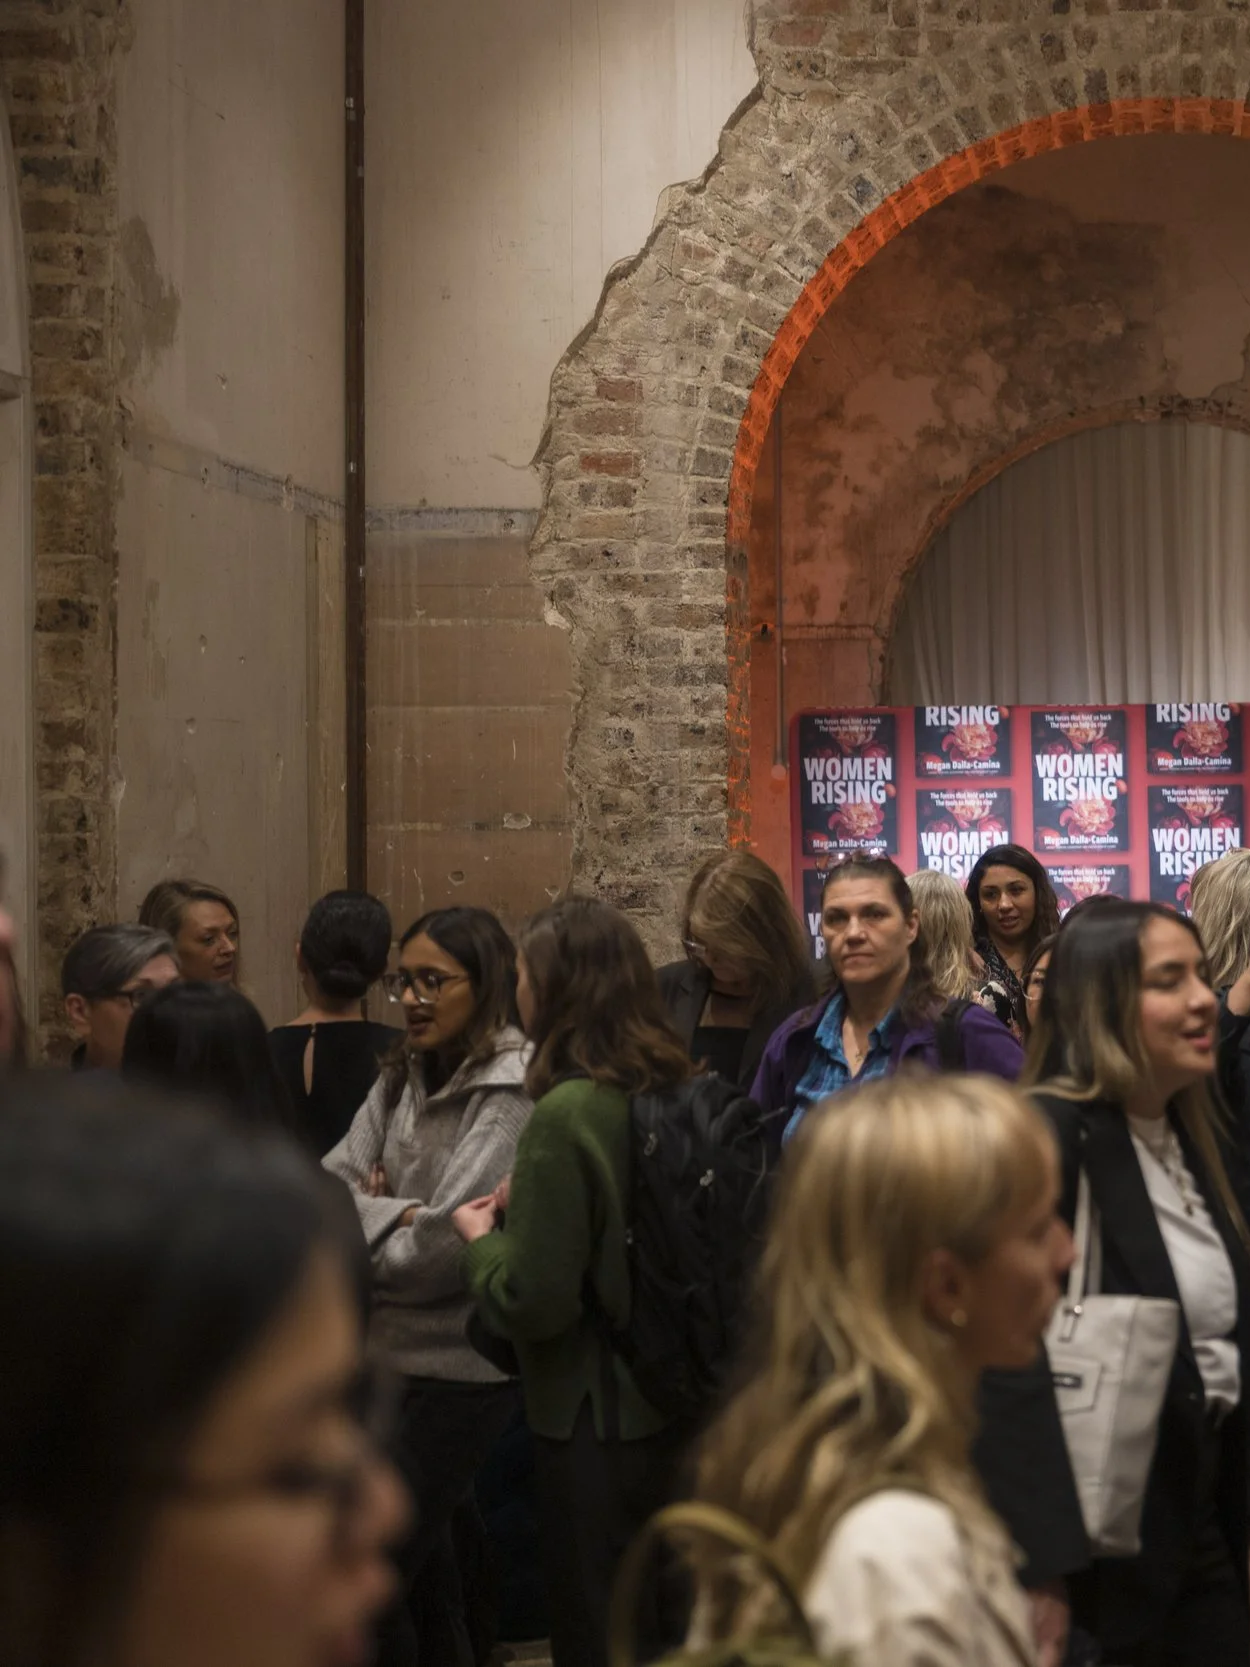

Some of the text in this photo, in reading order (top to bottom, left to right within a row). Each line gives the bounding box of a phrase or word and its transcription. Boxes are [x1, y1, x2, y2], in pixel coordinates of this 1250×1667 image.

[925, 705, 1000, 726] RISING
[1100, 713, 1112, 721] back
[1156, 703, 1230, 722] RISING
[840, 717, 850, 725] that
[803, 757, 892, 780] WOMEN
[926, 759, 1001, 773] Megan Dalla-Camina
[1035, 753, 1123, 778] WOMEN
[1158, 756, 1232, 768] Megan Dalla-Camina
[811, 780, 886, 804] RISING
[985, 791, 997, 799] back
[1043, 777, 1118, 801] RISING
[1162, 788, 1170, 796] The
[1171, 788, 1187, 796] forces
[1187, 788, 1198, 796] that
[813, 838, 887, 850] Megan Dalla-Camina
[1044, 834, 1119, 847] Megan Dalla-Camina
[1152, 828, 1240, 852] WOMEN
[928, 854, 979, 880] RISI
[1048, 868, 1057, 876] The
[1058, 868, 1073, 876] forces
[1073, 868, 1084, 876] that
[1103, 867, 1115, 876] back
